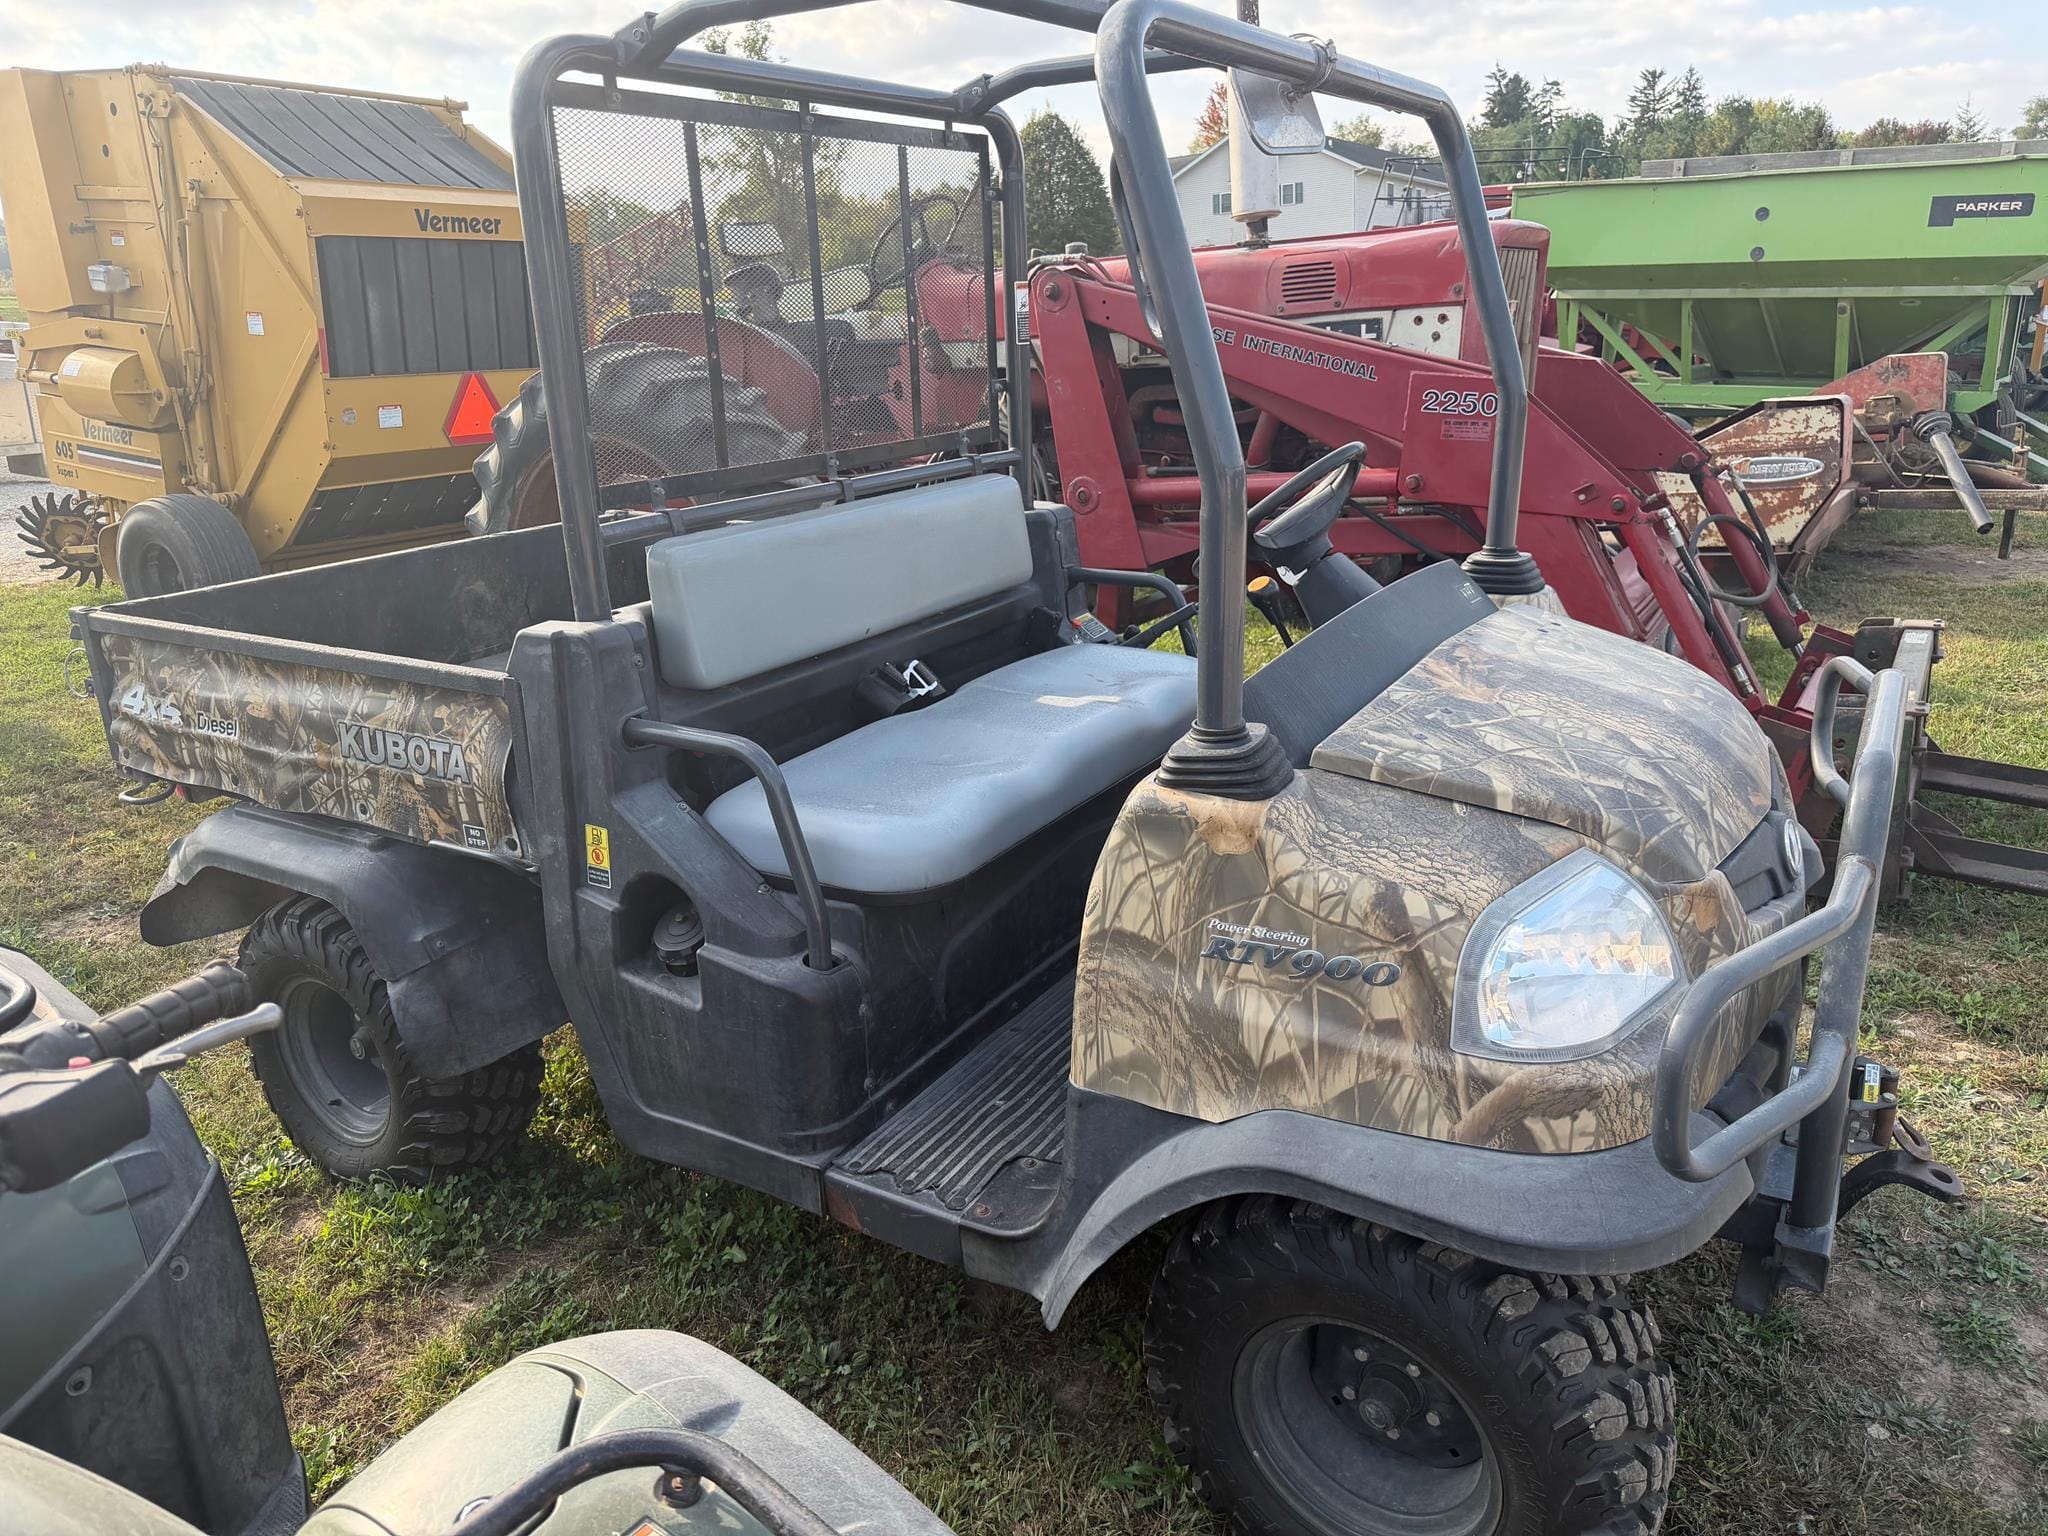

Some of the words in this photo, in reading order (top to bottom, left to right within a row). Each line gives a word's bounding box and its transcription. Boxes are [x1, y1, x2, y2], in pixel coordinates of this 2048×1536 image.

[1955, 201, 2022, 212] PARKER
[413, 207, 501, 236] Vermeer
[1212, 327, 1236, 344] SE
[1242, 334, 1378, 381] INTERNATIONAL
[1420, 389, 1498, 417] 2250
[81, 417, 134, 446] Vermeer
[55, 439, 74, 460] 605
[56, 464, 74, 479] Super
[1749, 463, 1782, 475] NEW
[196, 711, 238, 738] Diesel
[338, 722, 471, 785] KUBOTA
[467, 837, 487, 848] STEP
[469, 828, 481, 838] NO
[1207, 917, 1250, 935] Power
[1251, 925, 1311, 946] Steering
[1200, 934, 1402, 987] RTV900
